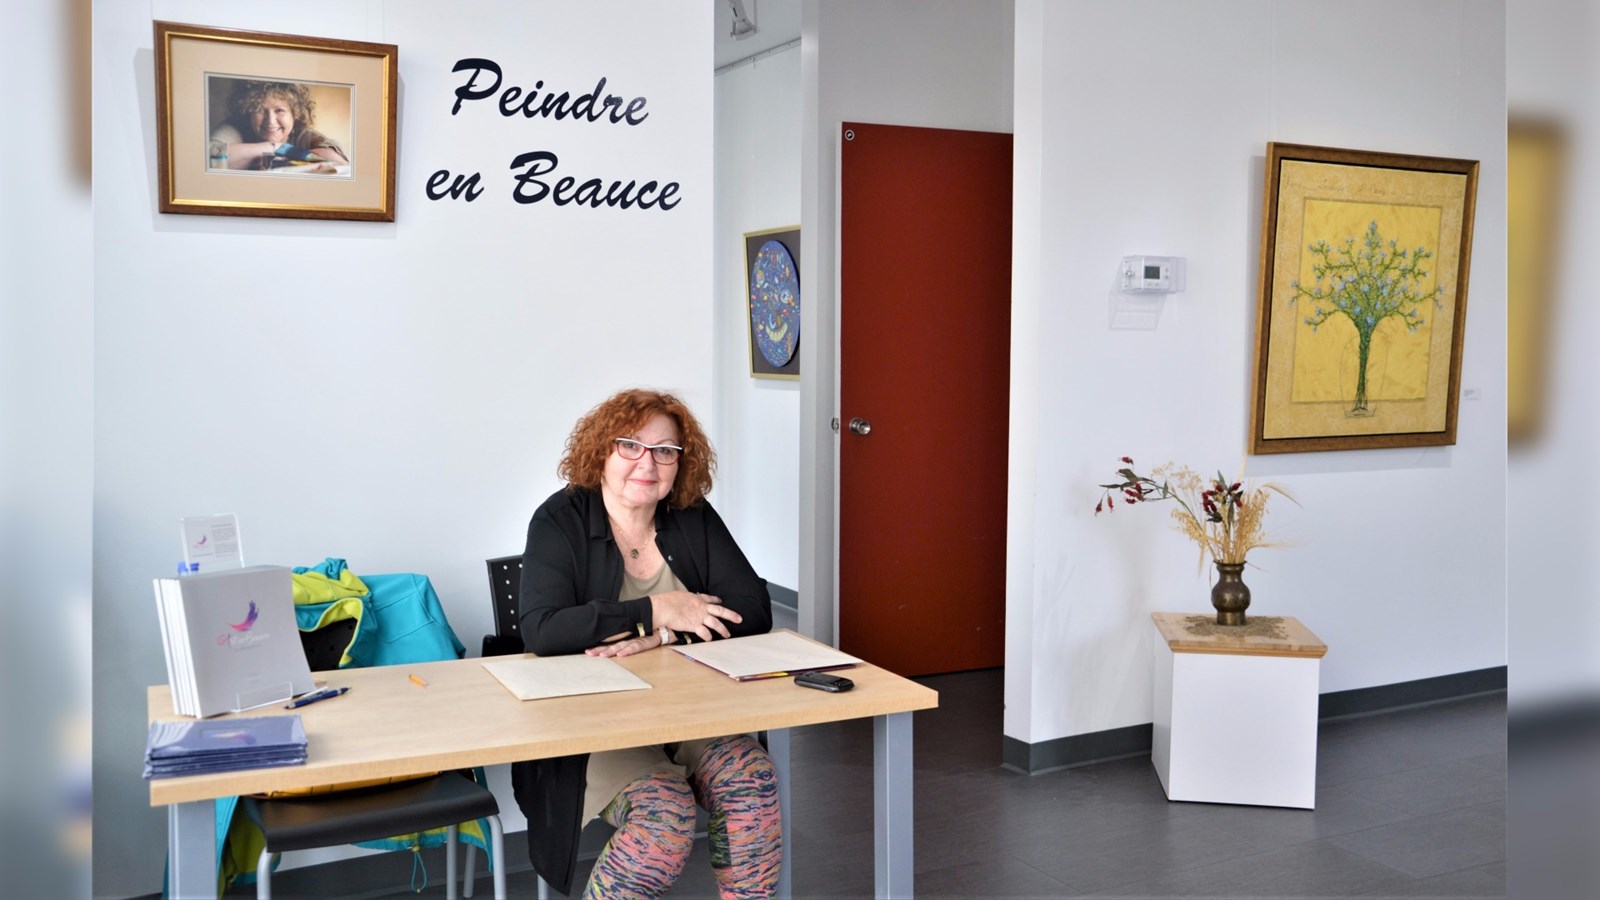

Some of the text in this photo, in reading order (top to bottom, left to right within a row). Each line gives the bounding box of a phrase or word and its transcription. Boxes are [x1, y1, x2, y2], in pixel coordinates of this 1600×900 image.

[451, 57, 649, 126] Peindre
[425, 150, 682, 211] en Beauce
